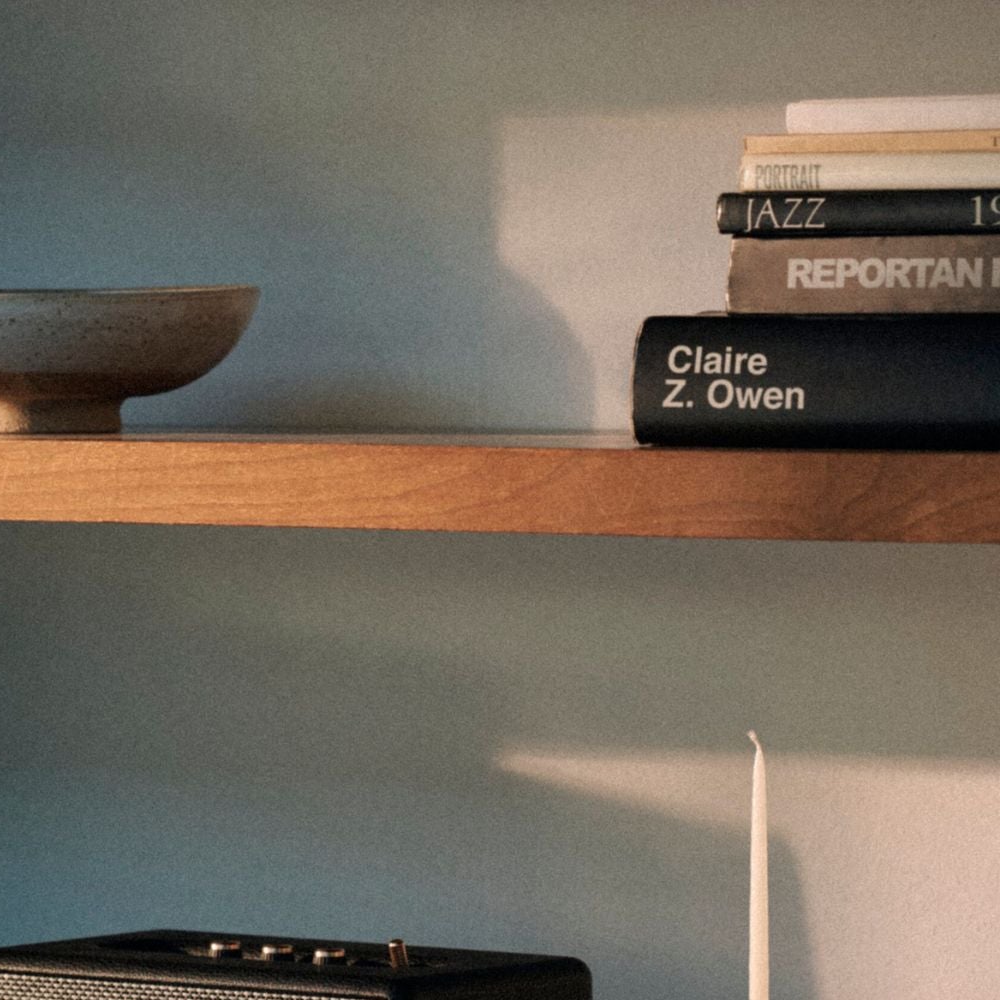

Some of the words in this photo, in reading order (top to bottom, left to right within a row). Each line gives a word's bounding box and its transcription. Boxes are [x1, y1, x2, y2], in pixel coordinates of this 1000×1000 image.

[755, 164, 822, 189] PORTRAIT
[744, 198, 826, 233] JAZZ
[786, 257, 984, 289] REPORTAN
[667, 345, 768, 375] Claire
[662, 379, 694, 408] Z.
[707, 378, 805, 410] Owen
